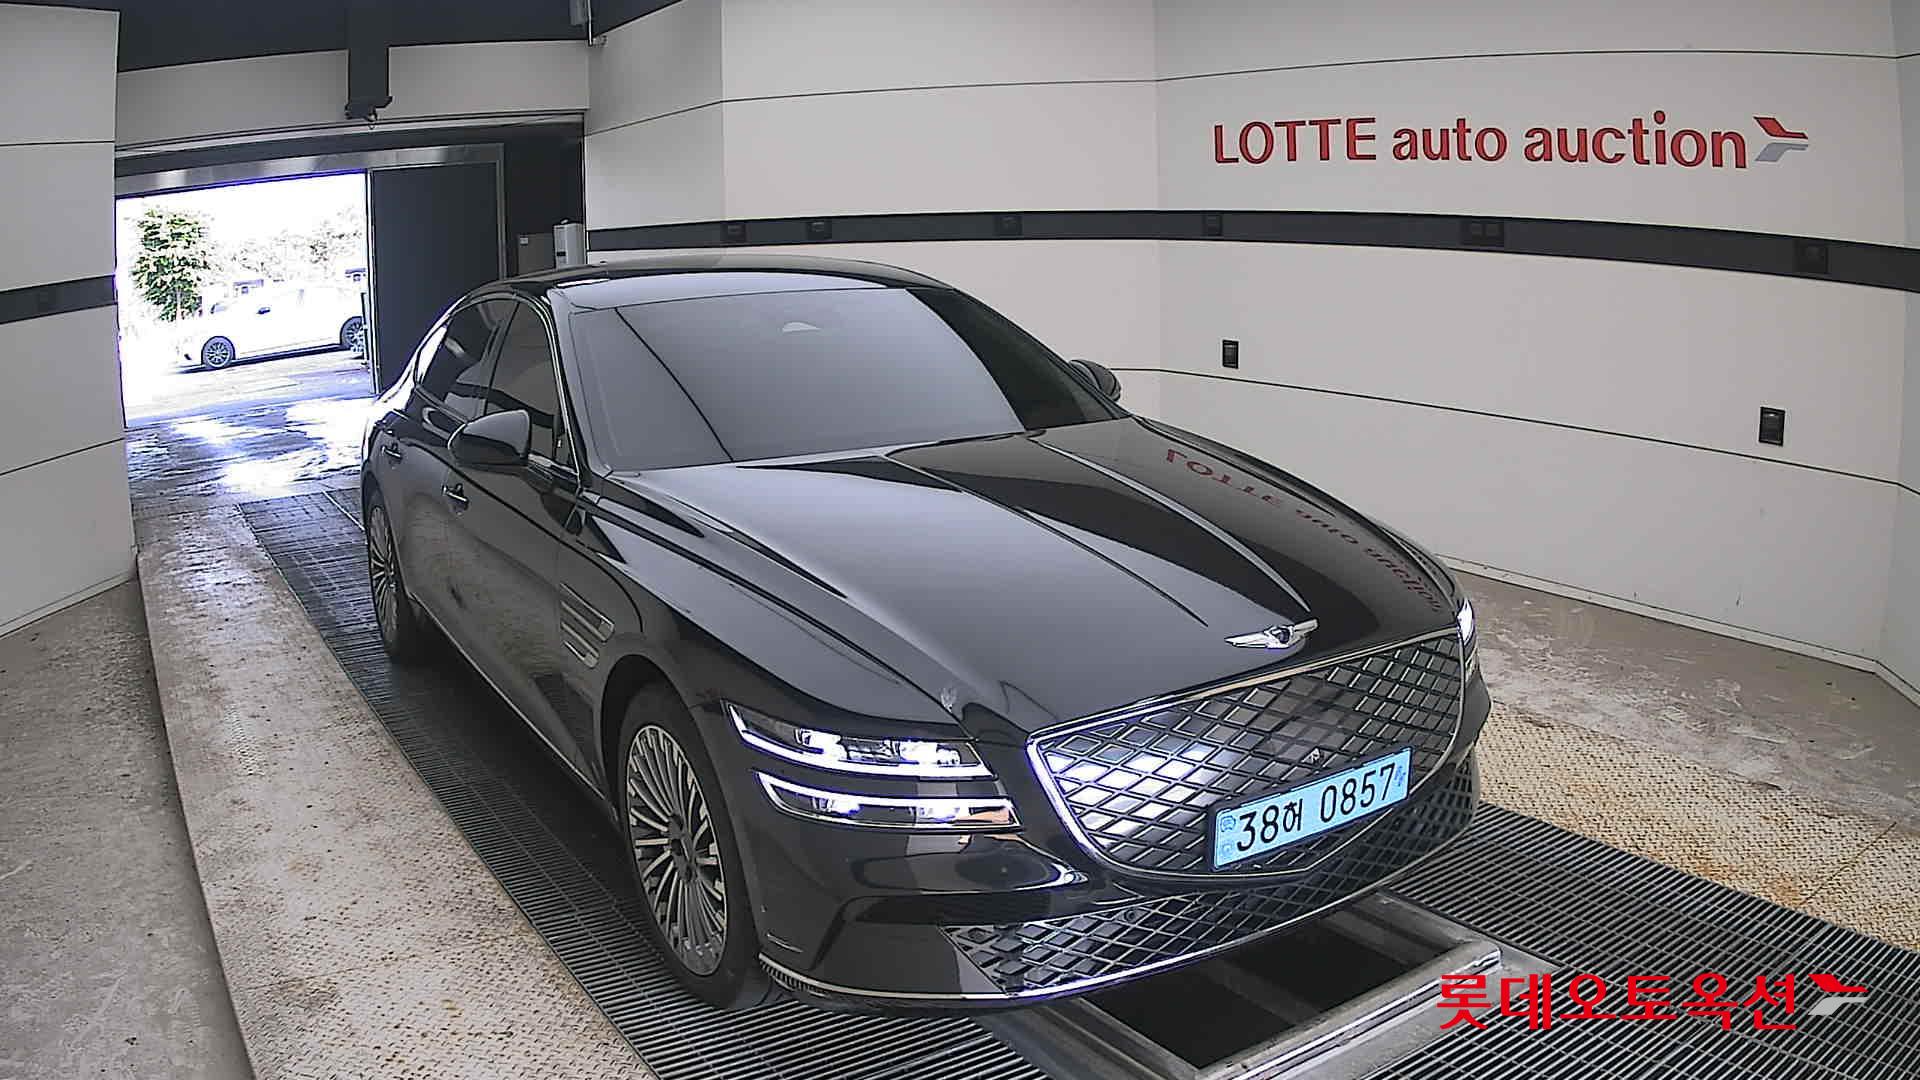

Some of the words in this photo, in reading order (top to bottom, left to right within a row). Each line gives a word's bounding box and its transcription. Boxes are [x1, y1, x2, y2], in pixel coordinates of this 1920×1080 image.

[1213, 116, 1377, 164] LOTTE
[1392, 117, 1509, 163] auto
[1523, 109, 1748, 169] auction
[1236, 798, 1304, 852] 38허
[1320, 762, 1397, 824] 0857
